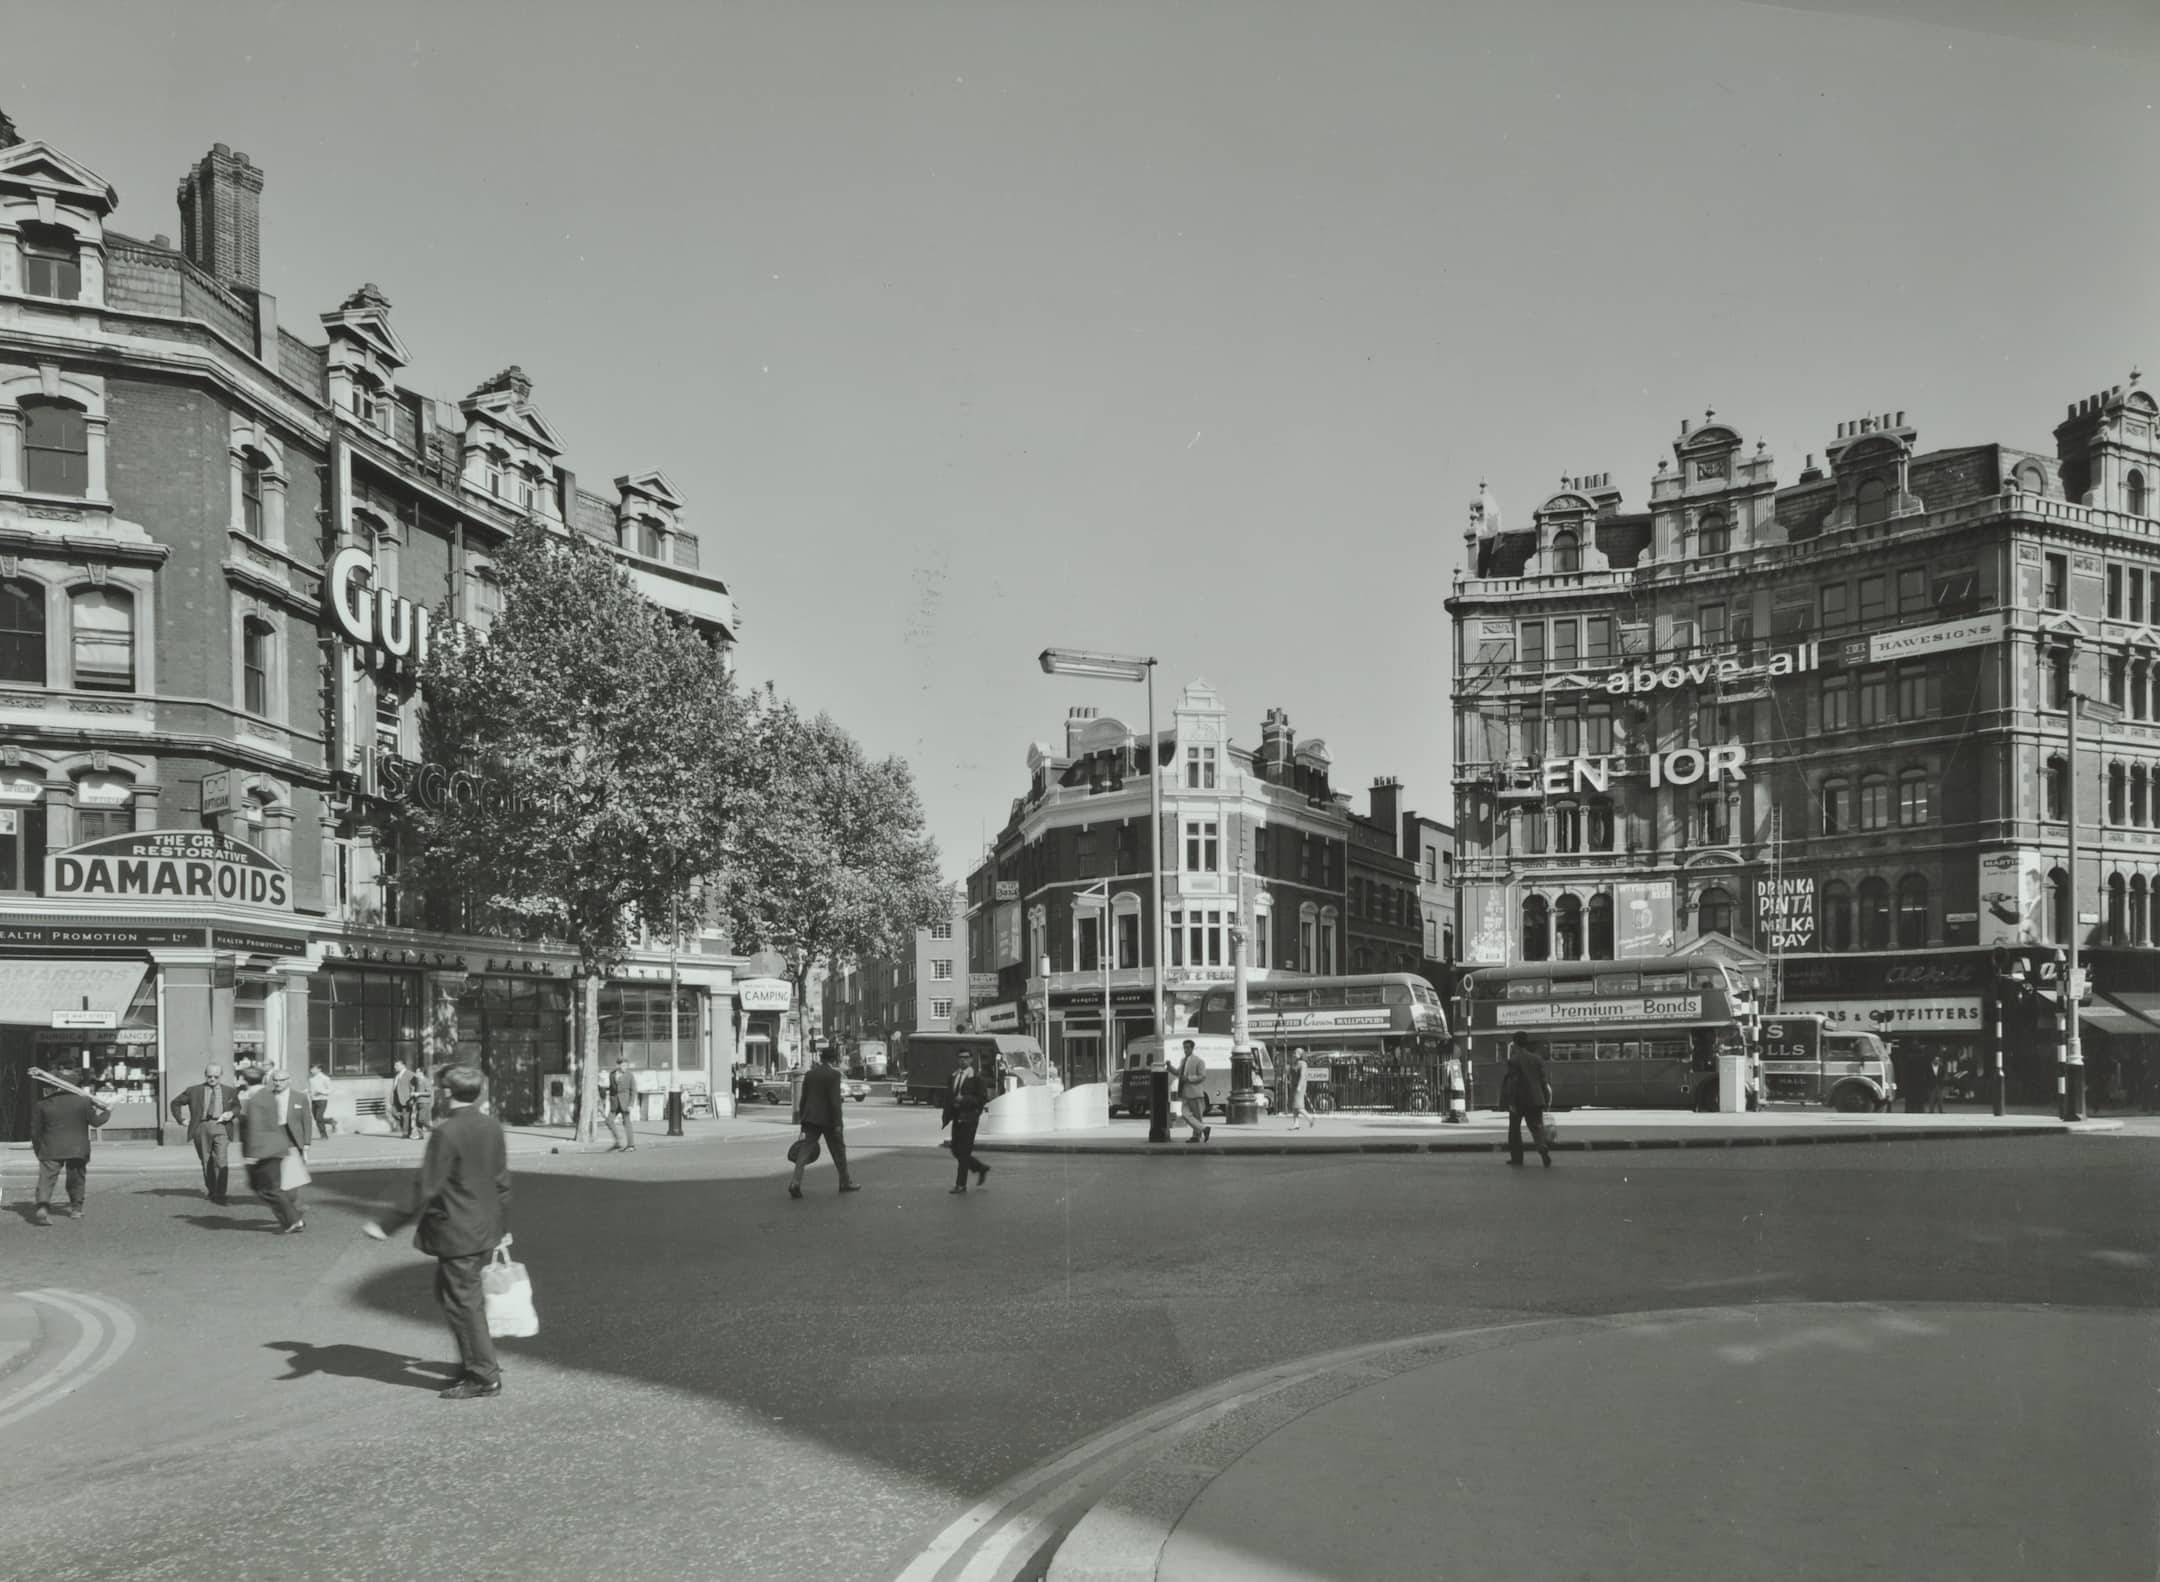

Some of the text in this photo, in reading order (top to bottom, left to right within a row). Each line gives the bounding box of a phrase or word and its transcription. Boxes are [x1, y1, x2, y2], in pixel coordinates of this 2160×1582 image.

[1879, 625, 1993, 651] HAWESIGNS
[1606, 641, 1819, 694] above all
[153, 835, 186, 846] THE
[132, 845, 249, 864] RESTORATIVE
[54, 857, 286, 906] DAMAROIDS
[1759, 894, 1812, 916] PINTA
[1761, 916, 1815, 933] MILKA
[52, 931, 138, 942] PROMOTION
[217, 936, 243, 945] HEALTH
[246, 939, 284, 949] PROMOTION
[1772, 933, 1812, 947] DAY
[744, 990, 790, 1003] CAMPING
[1550, 1003, 1624, 1018] Premium
[1643, 999, 1697, 1015] Bonds
